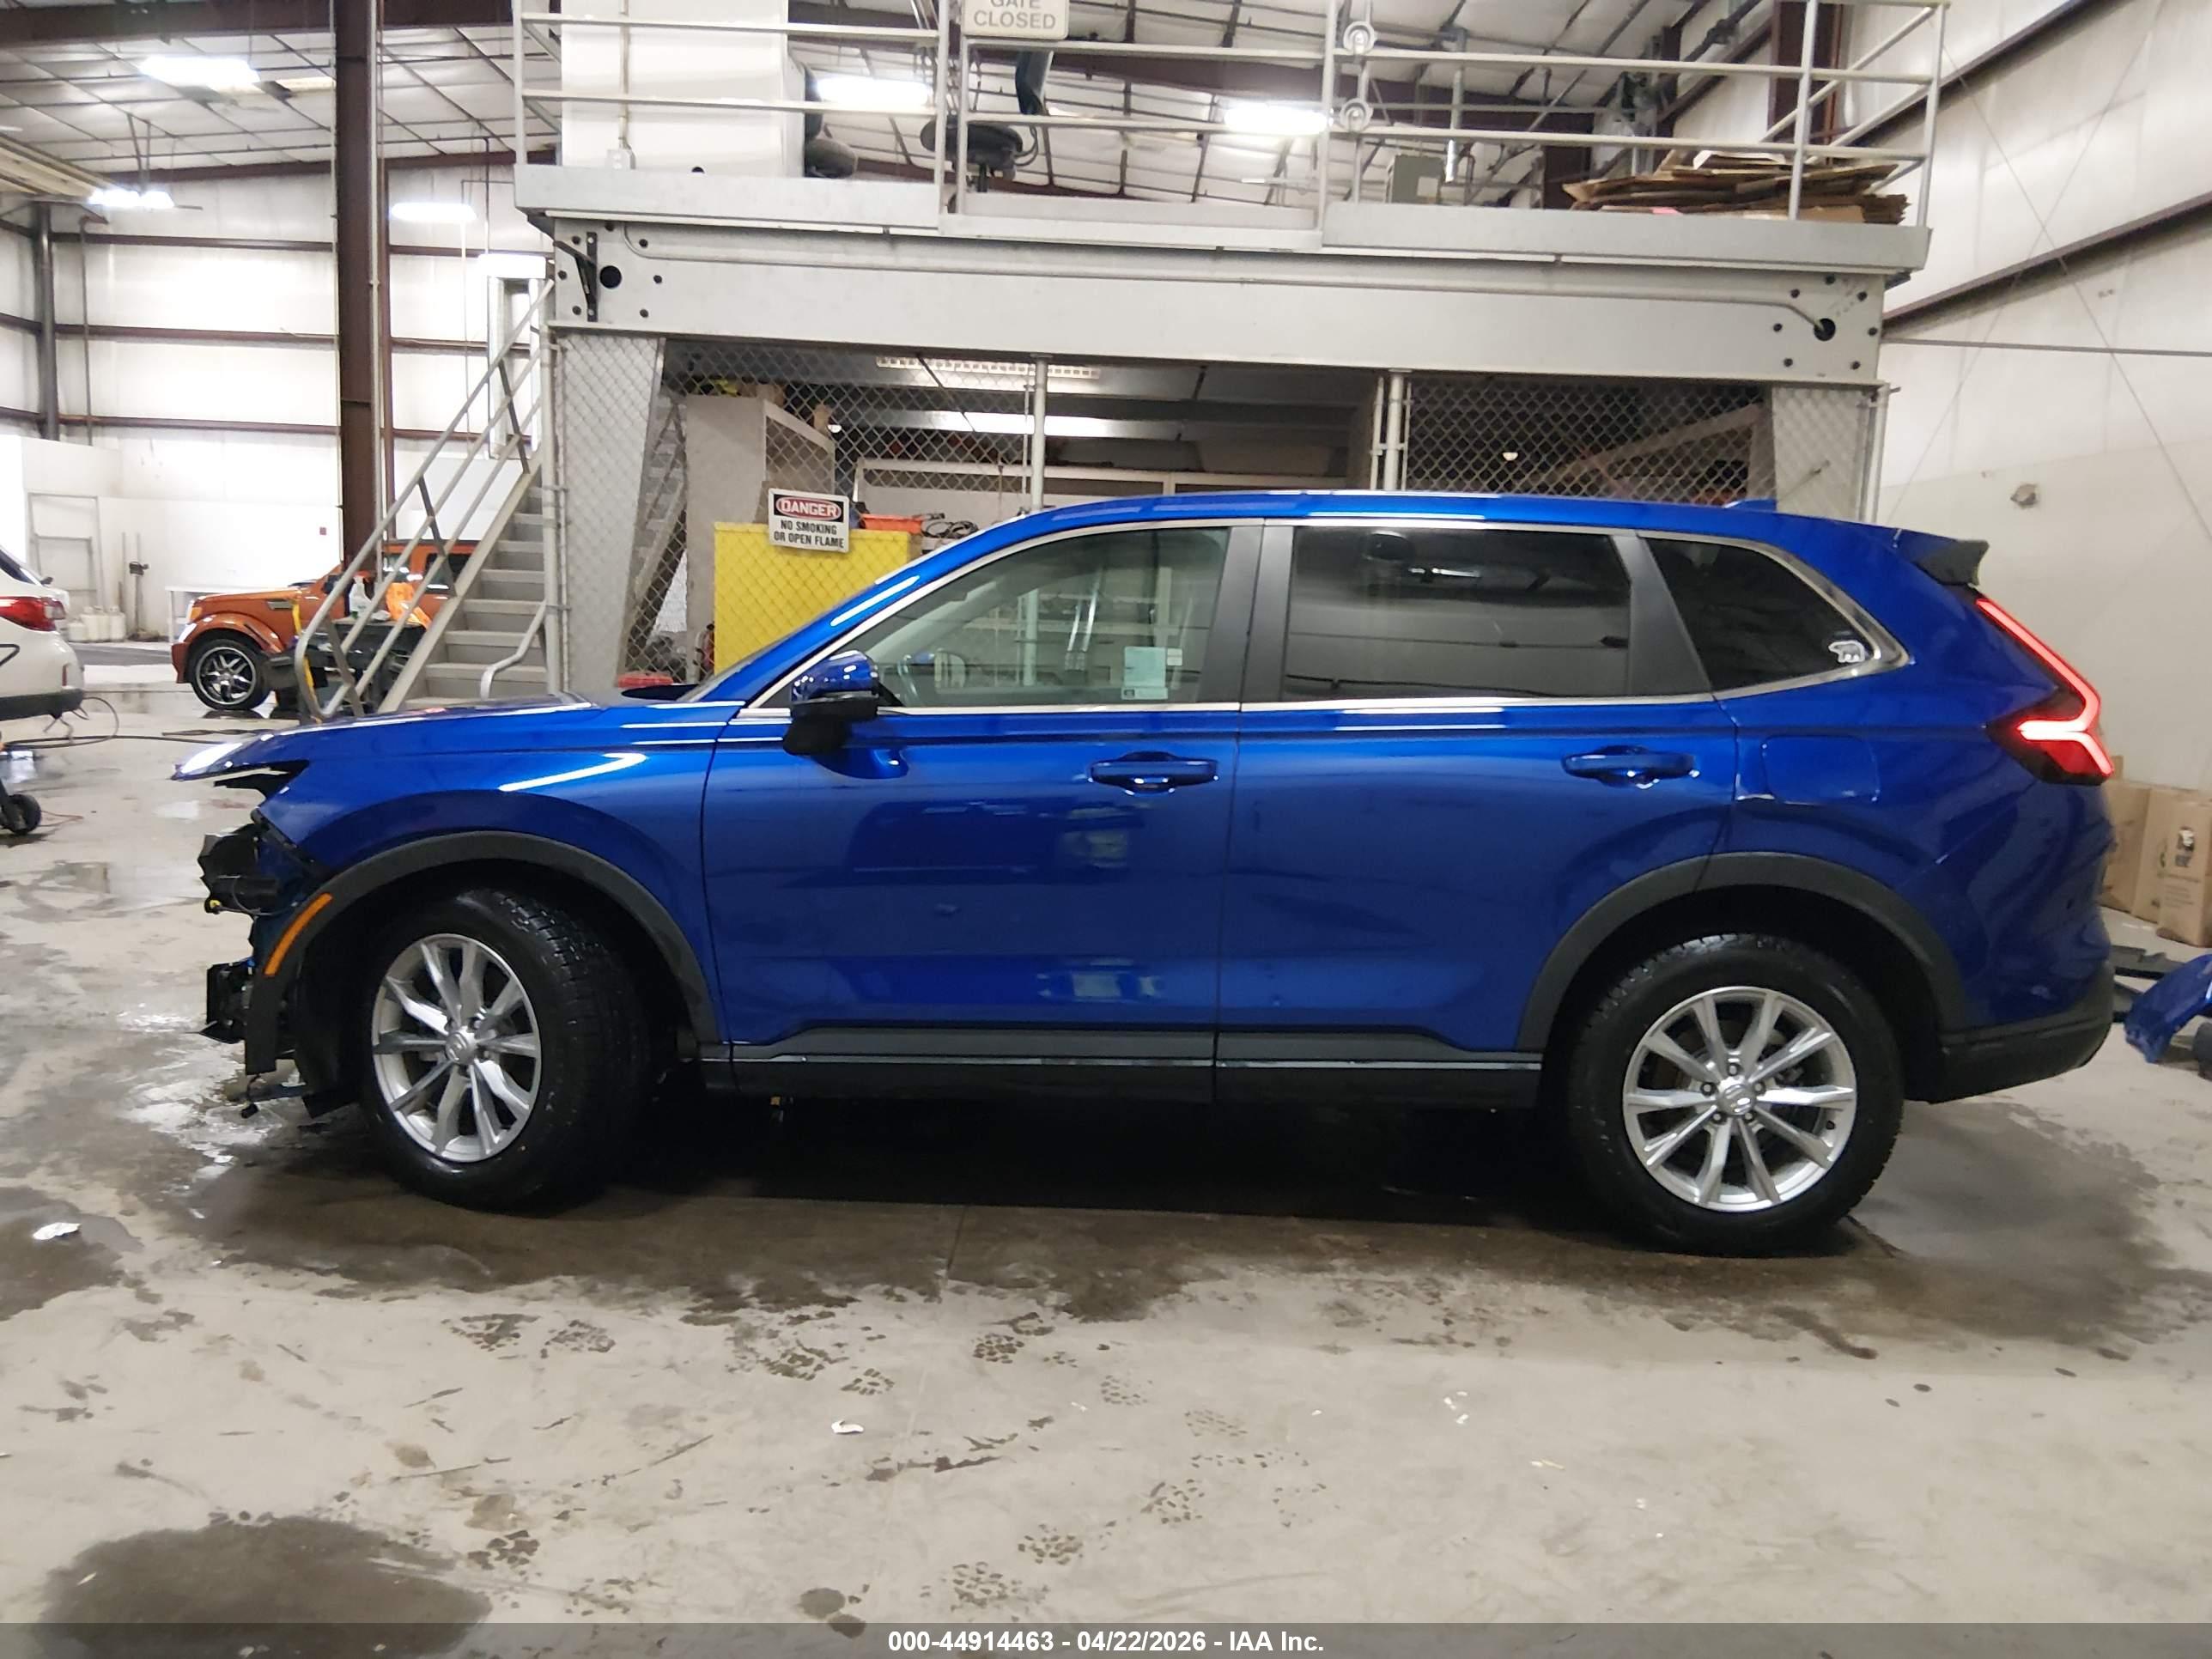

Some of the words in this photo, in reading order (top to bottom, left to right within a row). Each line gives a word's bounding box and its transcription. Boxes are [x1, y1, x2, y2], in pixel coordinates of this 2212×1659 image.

[973, 10, 1056, 29] CLOSED
[781, 500, 837, 517] DANGER
[781, 520, 793, 531] NO
[796, 521, 837, 535] SMOKING
[774, 531, 786, 542] OR
[788, 532, 811, 545] OPEN
[815, 536, 844, 549] FLAME
